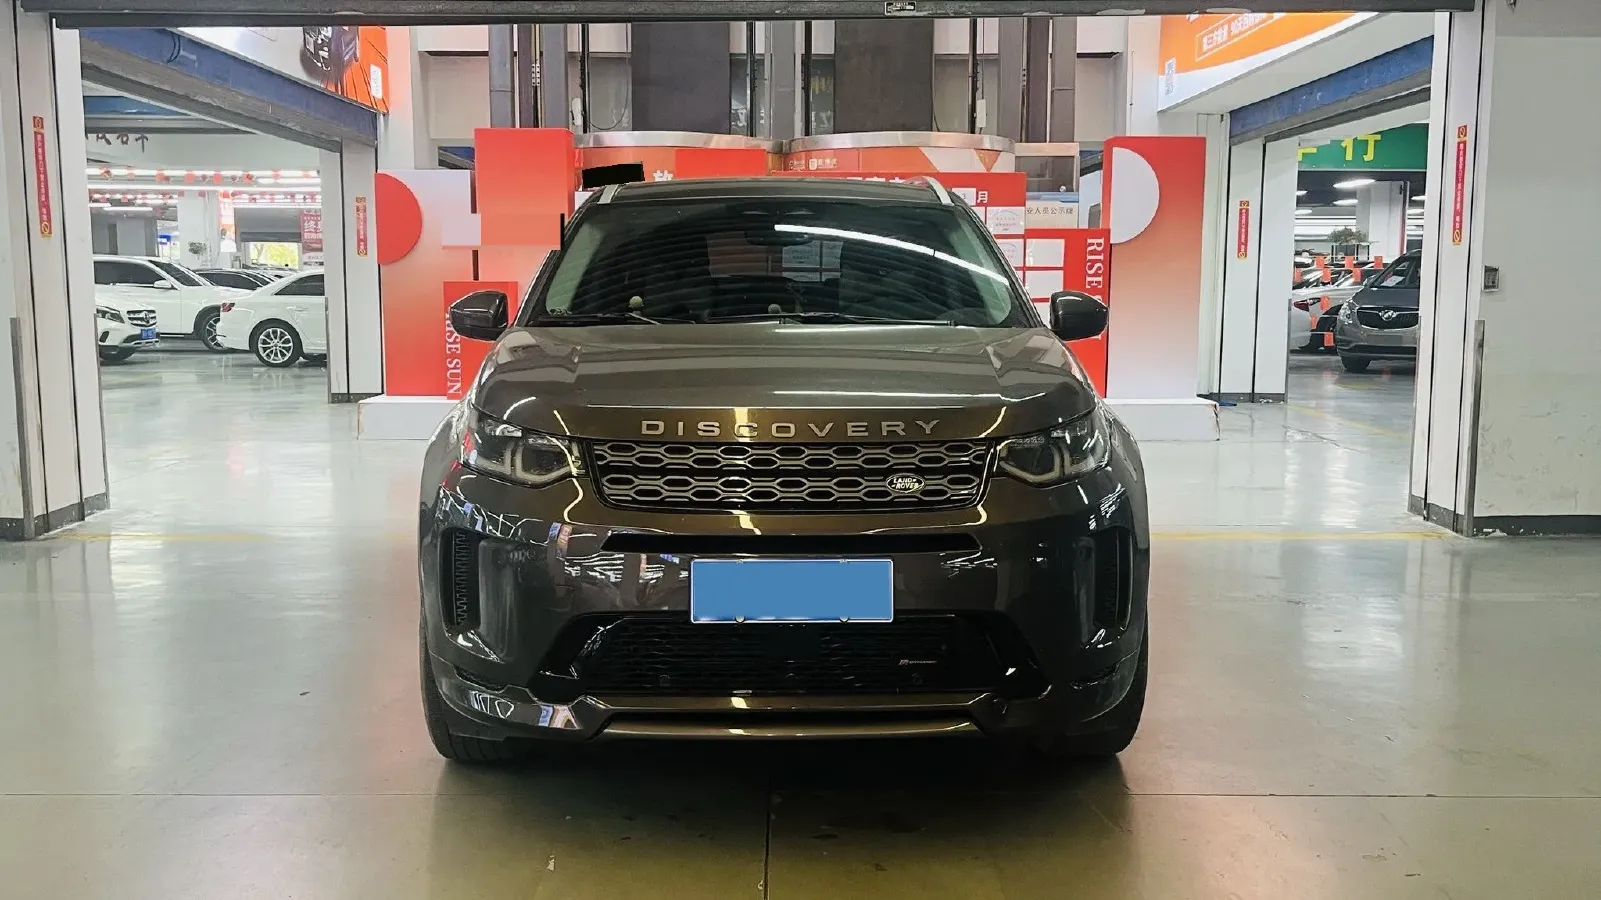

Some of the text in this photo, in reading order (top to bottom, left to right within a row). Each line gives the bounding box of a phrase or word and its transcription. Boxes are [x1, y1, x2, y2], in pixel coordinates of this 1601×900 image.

[977, 191, 989, 204] 月
[1085, 238, 1104, 289] RISE
[446, 358, 462, 395] SUN
[641, 419, 940, 437] DISCOVERY
